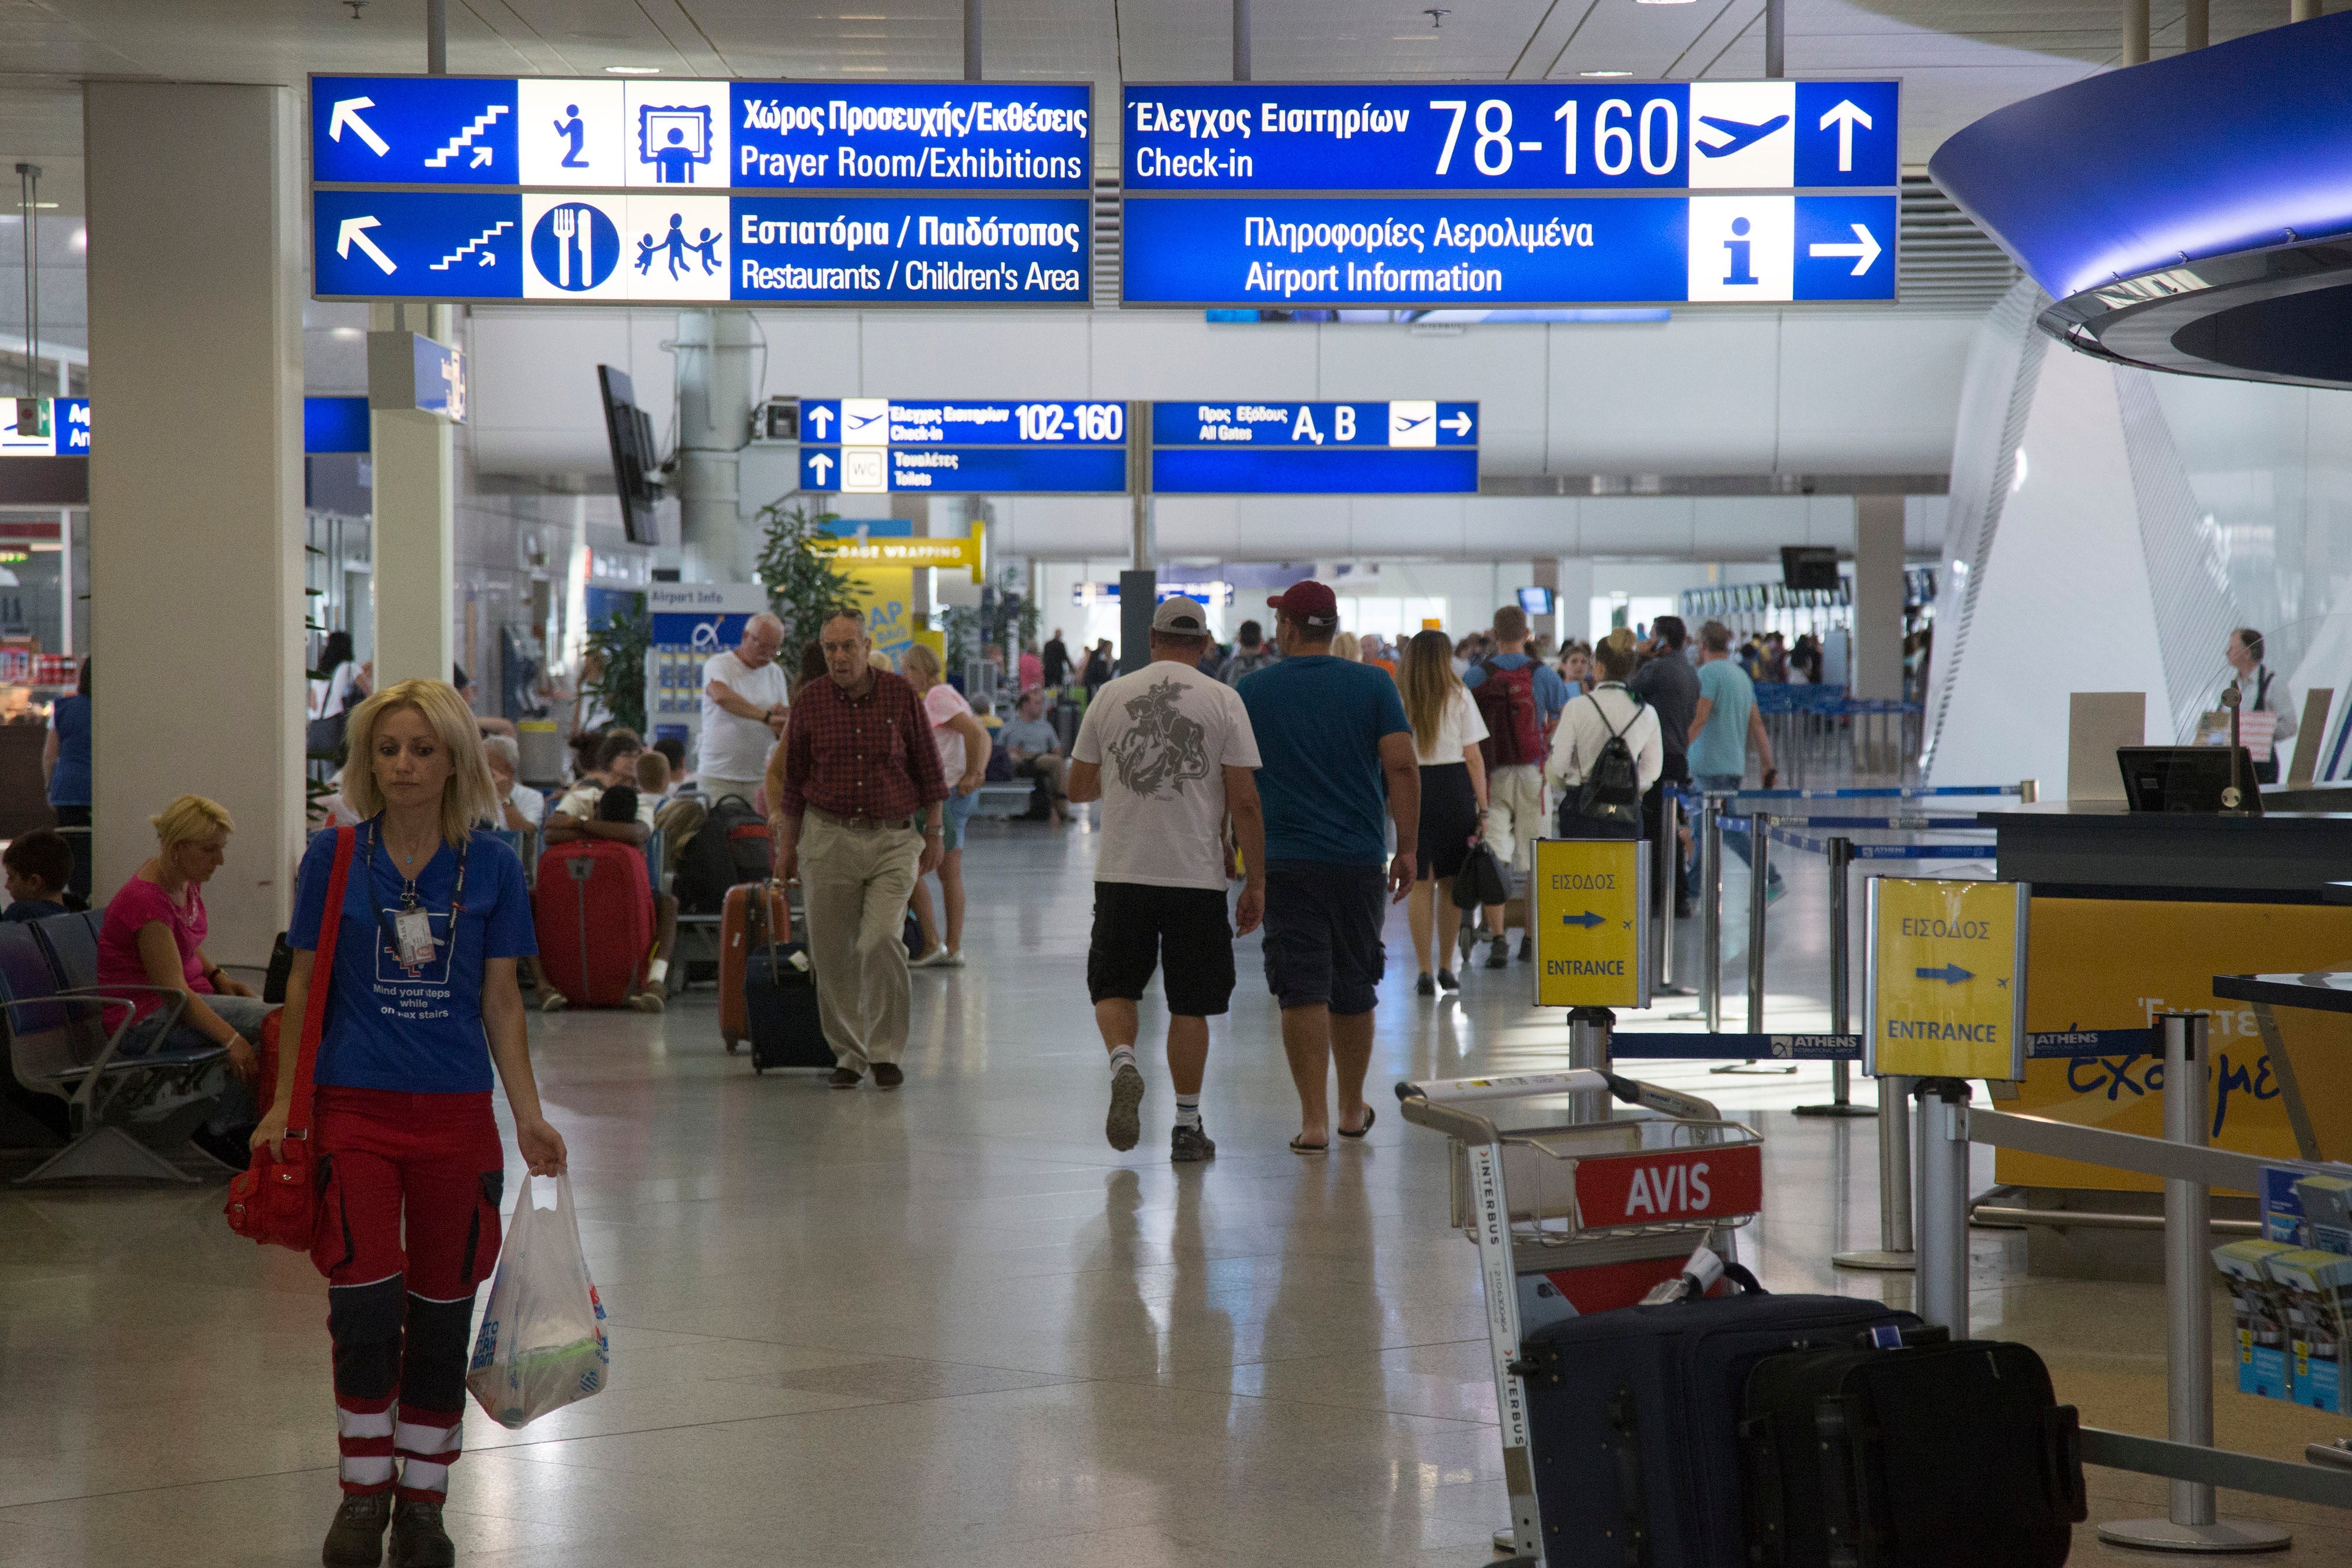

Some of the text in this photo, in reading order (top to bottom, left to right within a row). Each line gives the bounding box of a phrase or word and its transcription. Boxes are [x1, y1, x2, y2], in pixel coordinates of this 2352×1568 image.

[744, 99, 1087, 138] Χώρος Προσευχής/Εκθέσεις
[1128, 102, 1409, 138] Έλεγχος Εισιτηρίων
[1430, 99, 1678, 176] 78-160
[741, 146, 1081, 182] Prayer Room/Exhibitions
[1137, 148, 1252, 177] Check-in
[742, 215, 888, 251] Εστιατόρια
[920, 216, 1080, 252] Παιδότοπος
[1245, 217, 1593, 253] Πληροφορίες Αερολιμένα
[743, 260, 880, 290] Restaurants
[906, 261, 1018, 290] Children's
[1025, 262, 1079, 290] Area
[1245, 262, 1501, 297] Airport Information
[944, 406, 1010, 424] Εισιτηρίων
[1015, 404, 1122, 440] 102-160
[1198, 406, 1288, 423] Προς Εξόδους
[890, 425, 943, 440] Check-in
[1199, 424, 1252, 440] All Gates
[1292, 406, 1356, 445] A, B
[853, 463, 877, 477] WC
[894, 452, 958, 470] Τουαλέτες
[894, 471, 932, 486] Toilets
[883, 545, 961, 558] WRAPPING
[652, 591, 723, 604] Airport Info
[1552, 874, 1615, 890] ΕΙΣΟΔΟΣ
[1902, 918, 1990, 940] ΕΙΣΟΔΟΣ
[1547, 960, 1625, 975] ENTRANCE
[373, 984, 397, 995] Mind
[400, 989, 424, 998] your
[400, 999, 428, 1008] while
[419, 1010, 449, 1019] stairs
[1888, 1019, 1997, 1043] ENTRANCE
[2037, 1033, 2099, 1044] ATHENS
[1795, 1037, 1857, 1047] ATHENS
[1626, 1163, 1711, 1216] AVIS
[1481, 1160, 1499, 1245] INTERBUS
